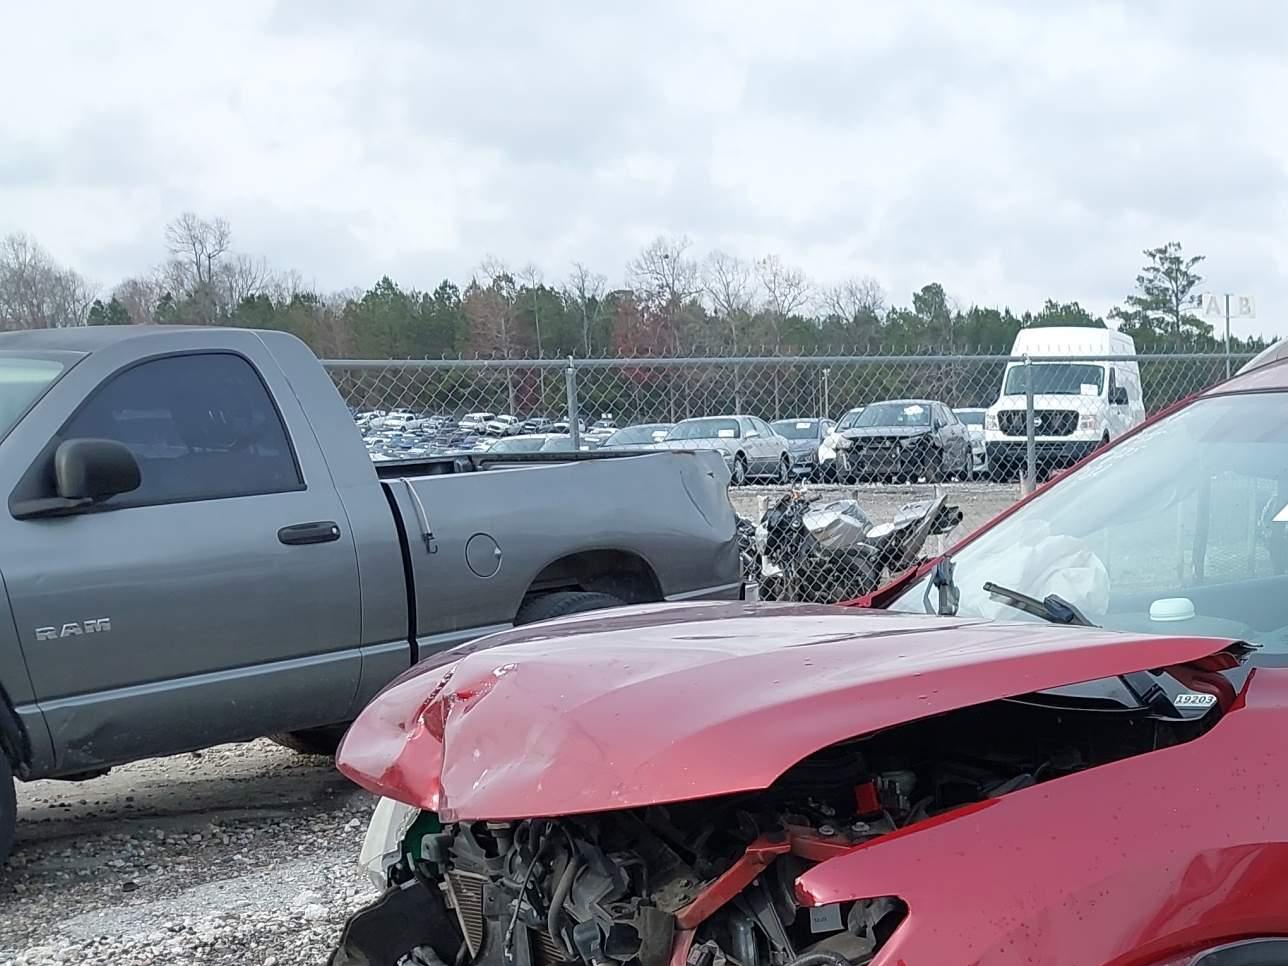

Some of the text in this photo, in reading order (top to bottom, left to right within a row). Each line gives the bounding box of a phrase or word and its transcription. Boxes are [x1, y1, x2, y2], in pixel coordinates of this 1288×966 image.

[1205, 295, 1251, 315] A B
[35, 617, 111, 641] RAM
[1175, 695, 1215, 705] 19203
